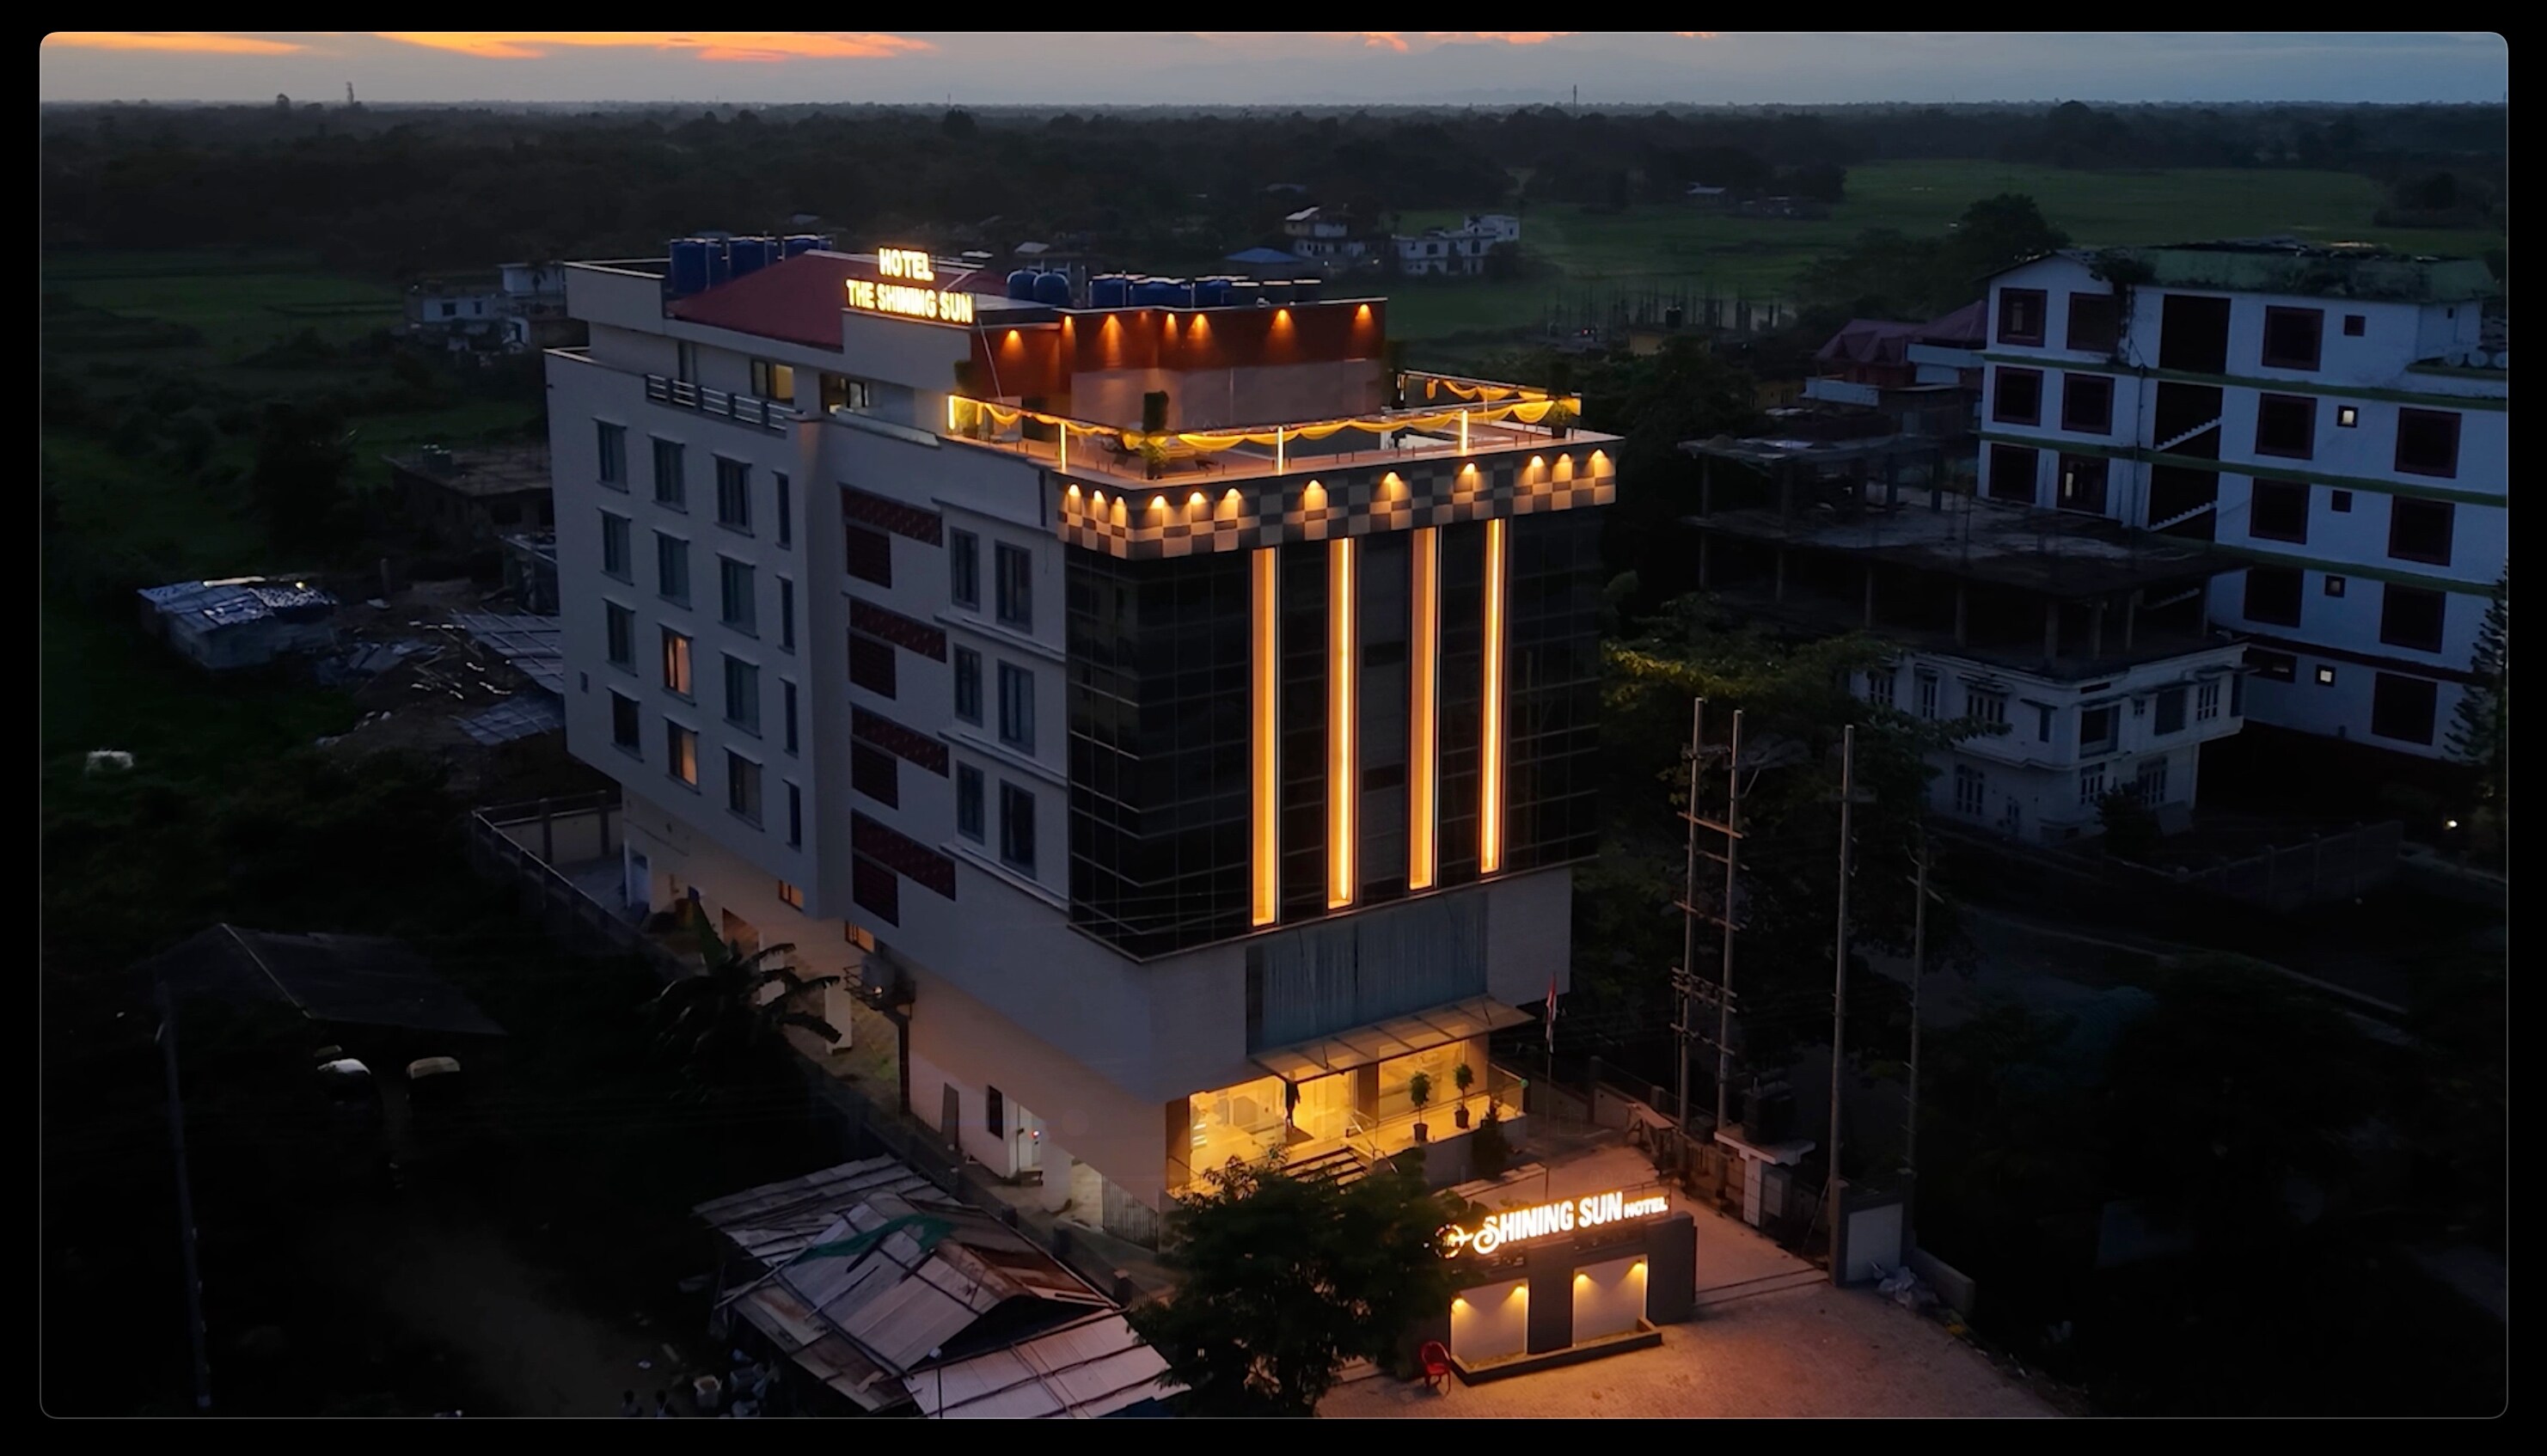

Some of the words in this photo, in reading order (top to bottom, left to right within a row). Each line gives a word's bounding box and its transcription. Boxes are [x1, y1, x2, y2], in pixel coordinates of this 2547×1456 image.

[878, 247, 934, 281] HOTEL
[846, 278, 875, 309] THE
[877, 283, 937, 318] SHINING
[939, 291, 973, 323] SUN
[1472, 1200, 1574, 1254] SHINING
[1578, 1191, 1623, 1228] SUN
[1624, 1196, 1668, 1219] HOTEL
